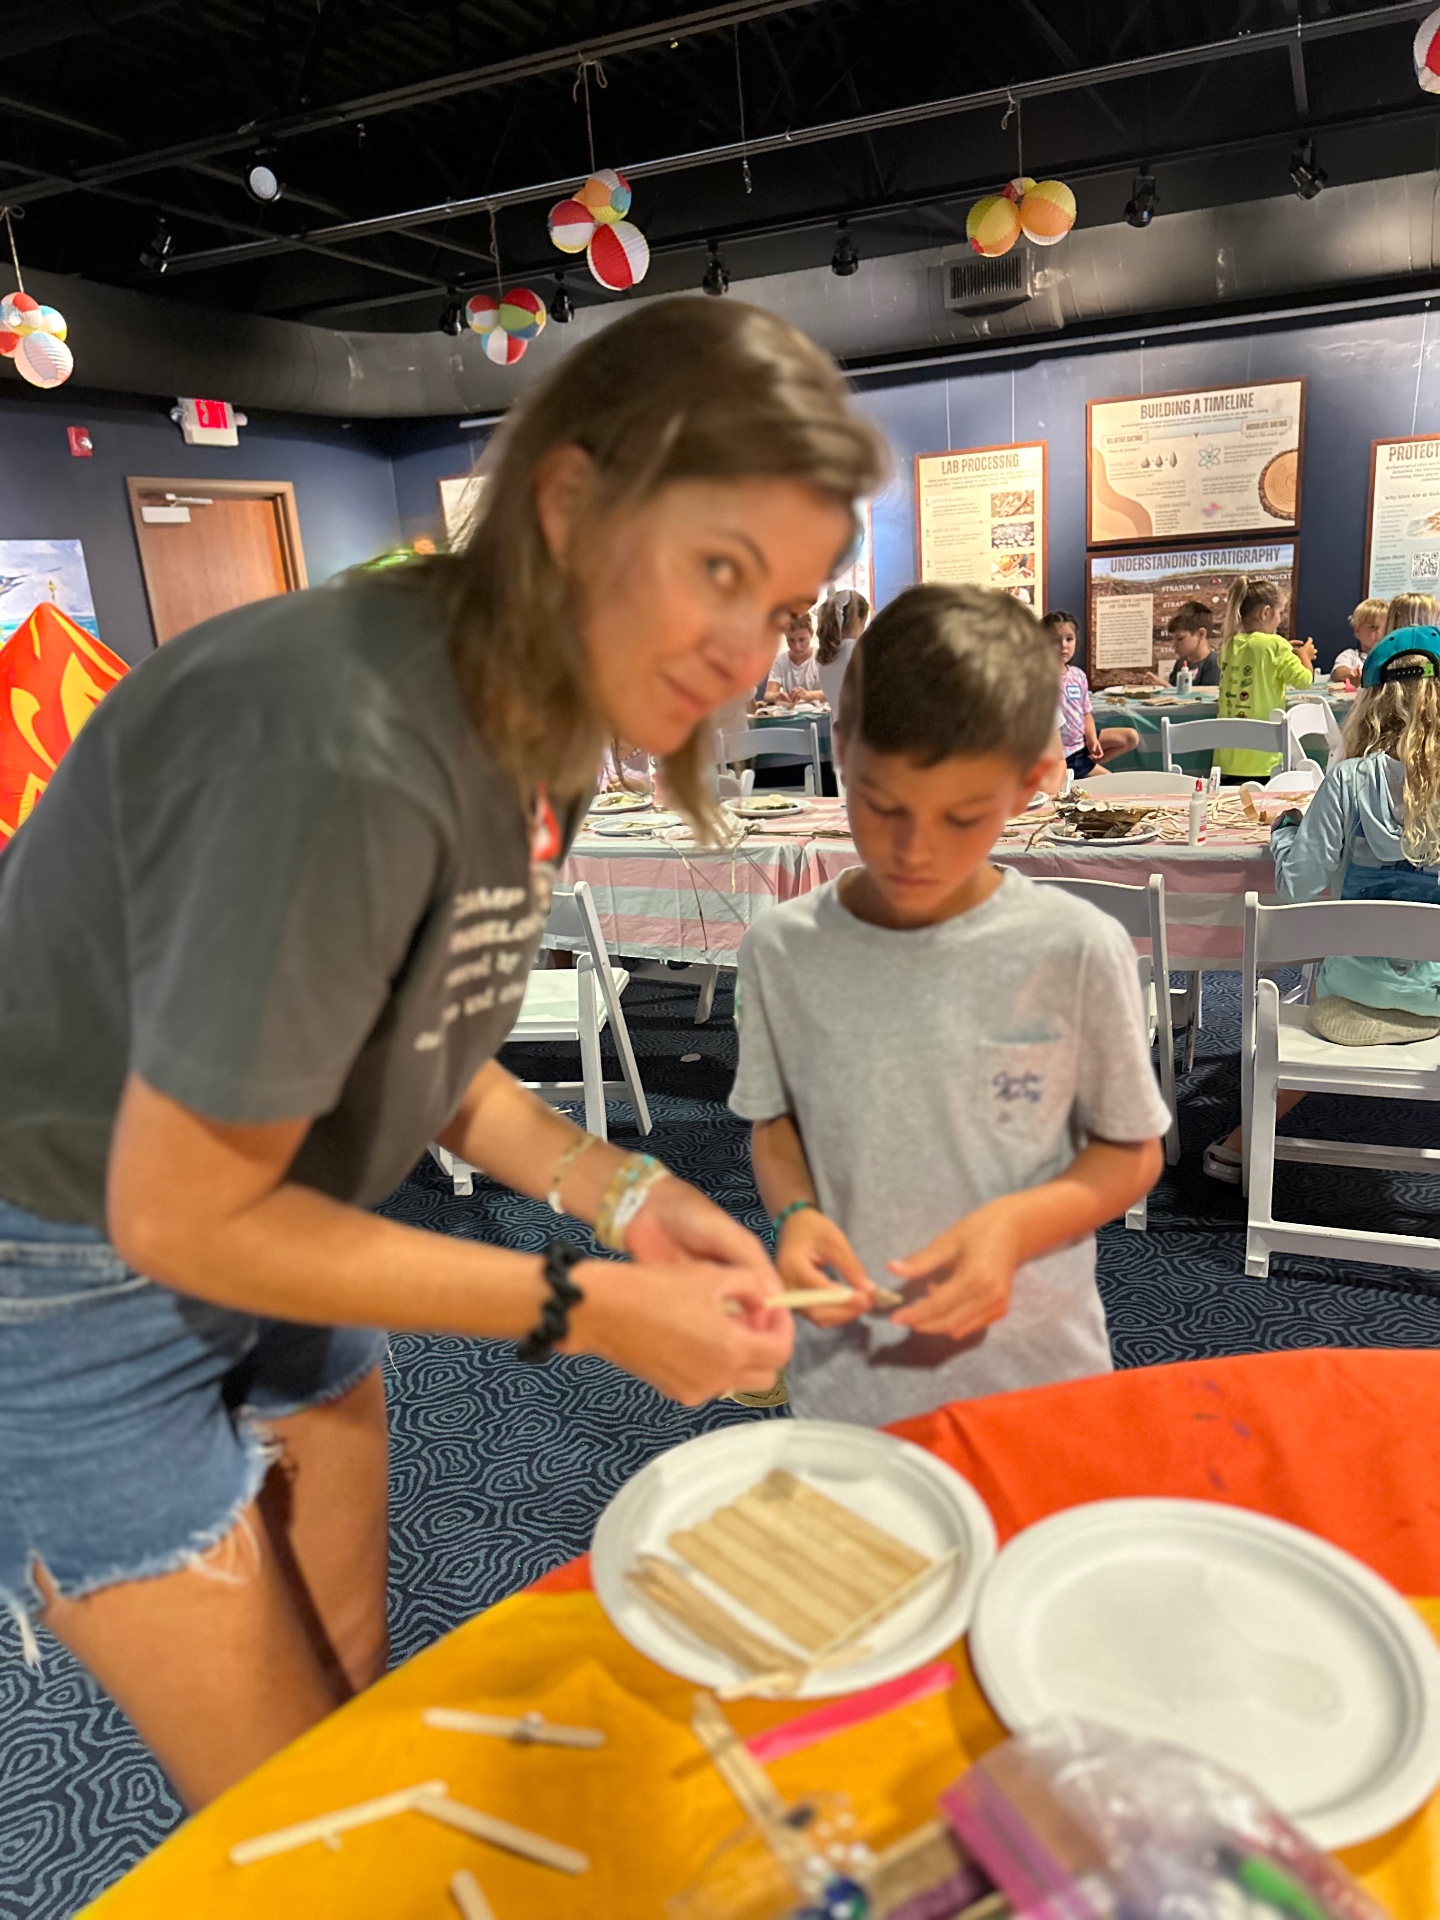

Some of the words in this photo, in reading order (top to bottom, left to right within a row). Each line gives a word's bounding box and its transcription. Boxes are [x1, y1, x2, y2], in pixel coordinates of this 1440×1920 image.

[1140, 399, 1191, 419] BUILDING
[1193, 398, 1201, 414] A
[1203, 392, 1254, 413] TIMELINE
[1245, 421, 1269, 431] ABSOLUTE
[1269, 419, 1288, 428] DATING
[1126, 434, 1143, 443] DATING
[1388, 443, 1440, 461] PROTECT
[941, 459, 959, 475] LAB
[961, 453, 1019, 473] PROCESSNG
[1110, 553, 1197, 573] UNDERSTANDING
[1200, 547, 1281, 567] STRATIGRAPHY
[1255, 572, 1292, 581] YOUNGEST
[1161, 584, 1194, 593] STRATUM
[1163, 600, 1187, 608] STRAT
